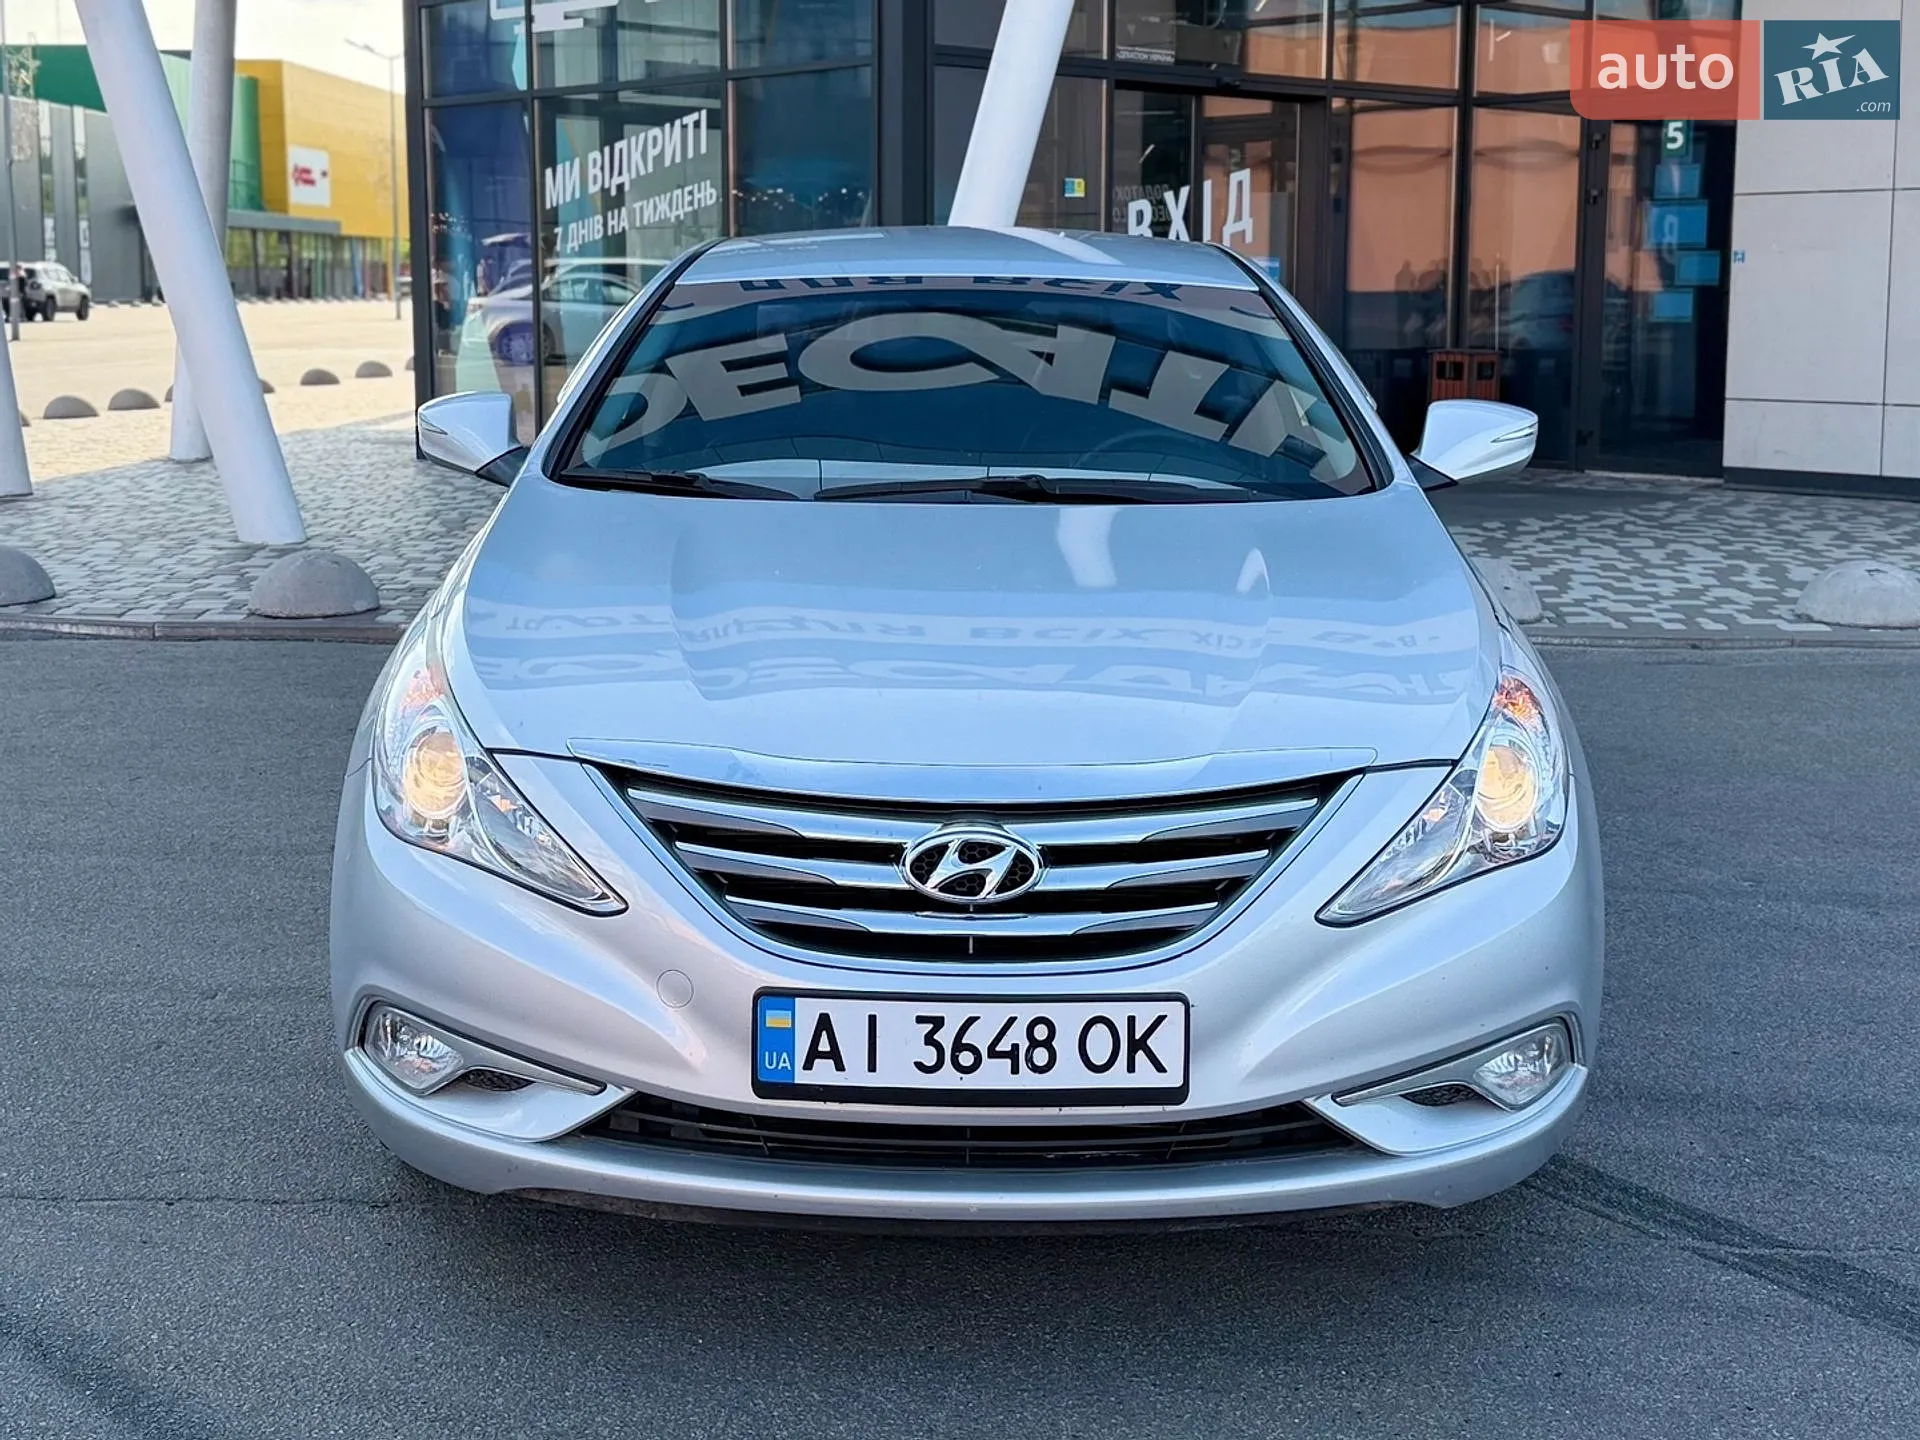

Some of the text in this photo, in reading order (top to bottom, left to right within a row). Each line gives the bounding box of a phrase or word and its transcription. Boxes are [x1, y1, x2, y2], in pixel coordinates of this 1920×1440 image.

[545, 109, 708, 210] МИ ВІДКРИТІ
[1666, 121, 1685, 150] 5
[554, 226, 563, 253] 7
[566, 213, 604, 254] ДНІВ
[607, 206, 630, 236] НА
[1128, 168, 1254, 247] ВХІД
[765, 1051, 792, 1070] UA
[802, 1012, 1168, 1075] AI 3648 OK
